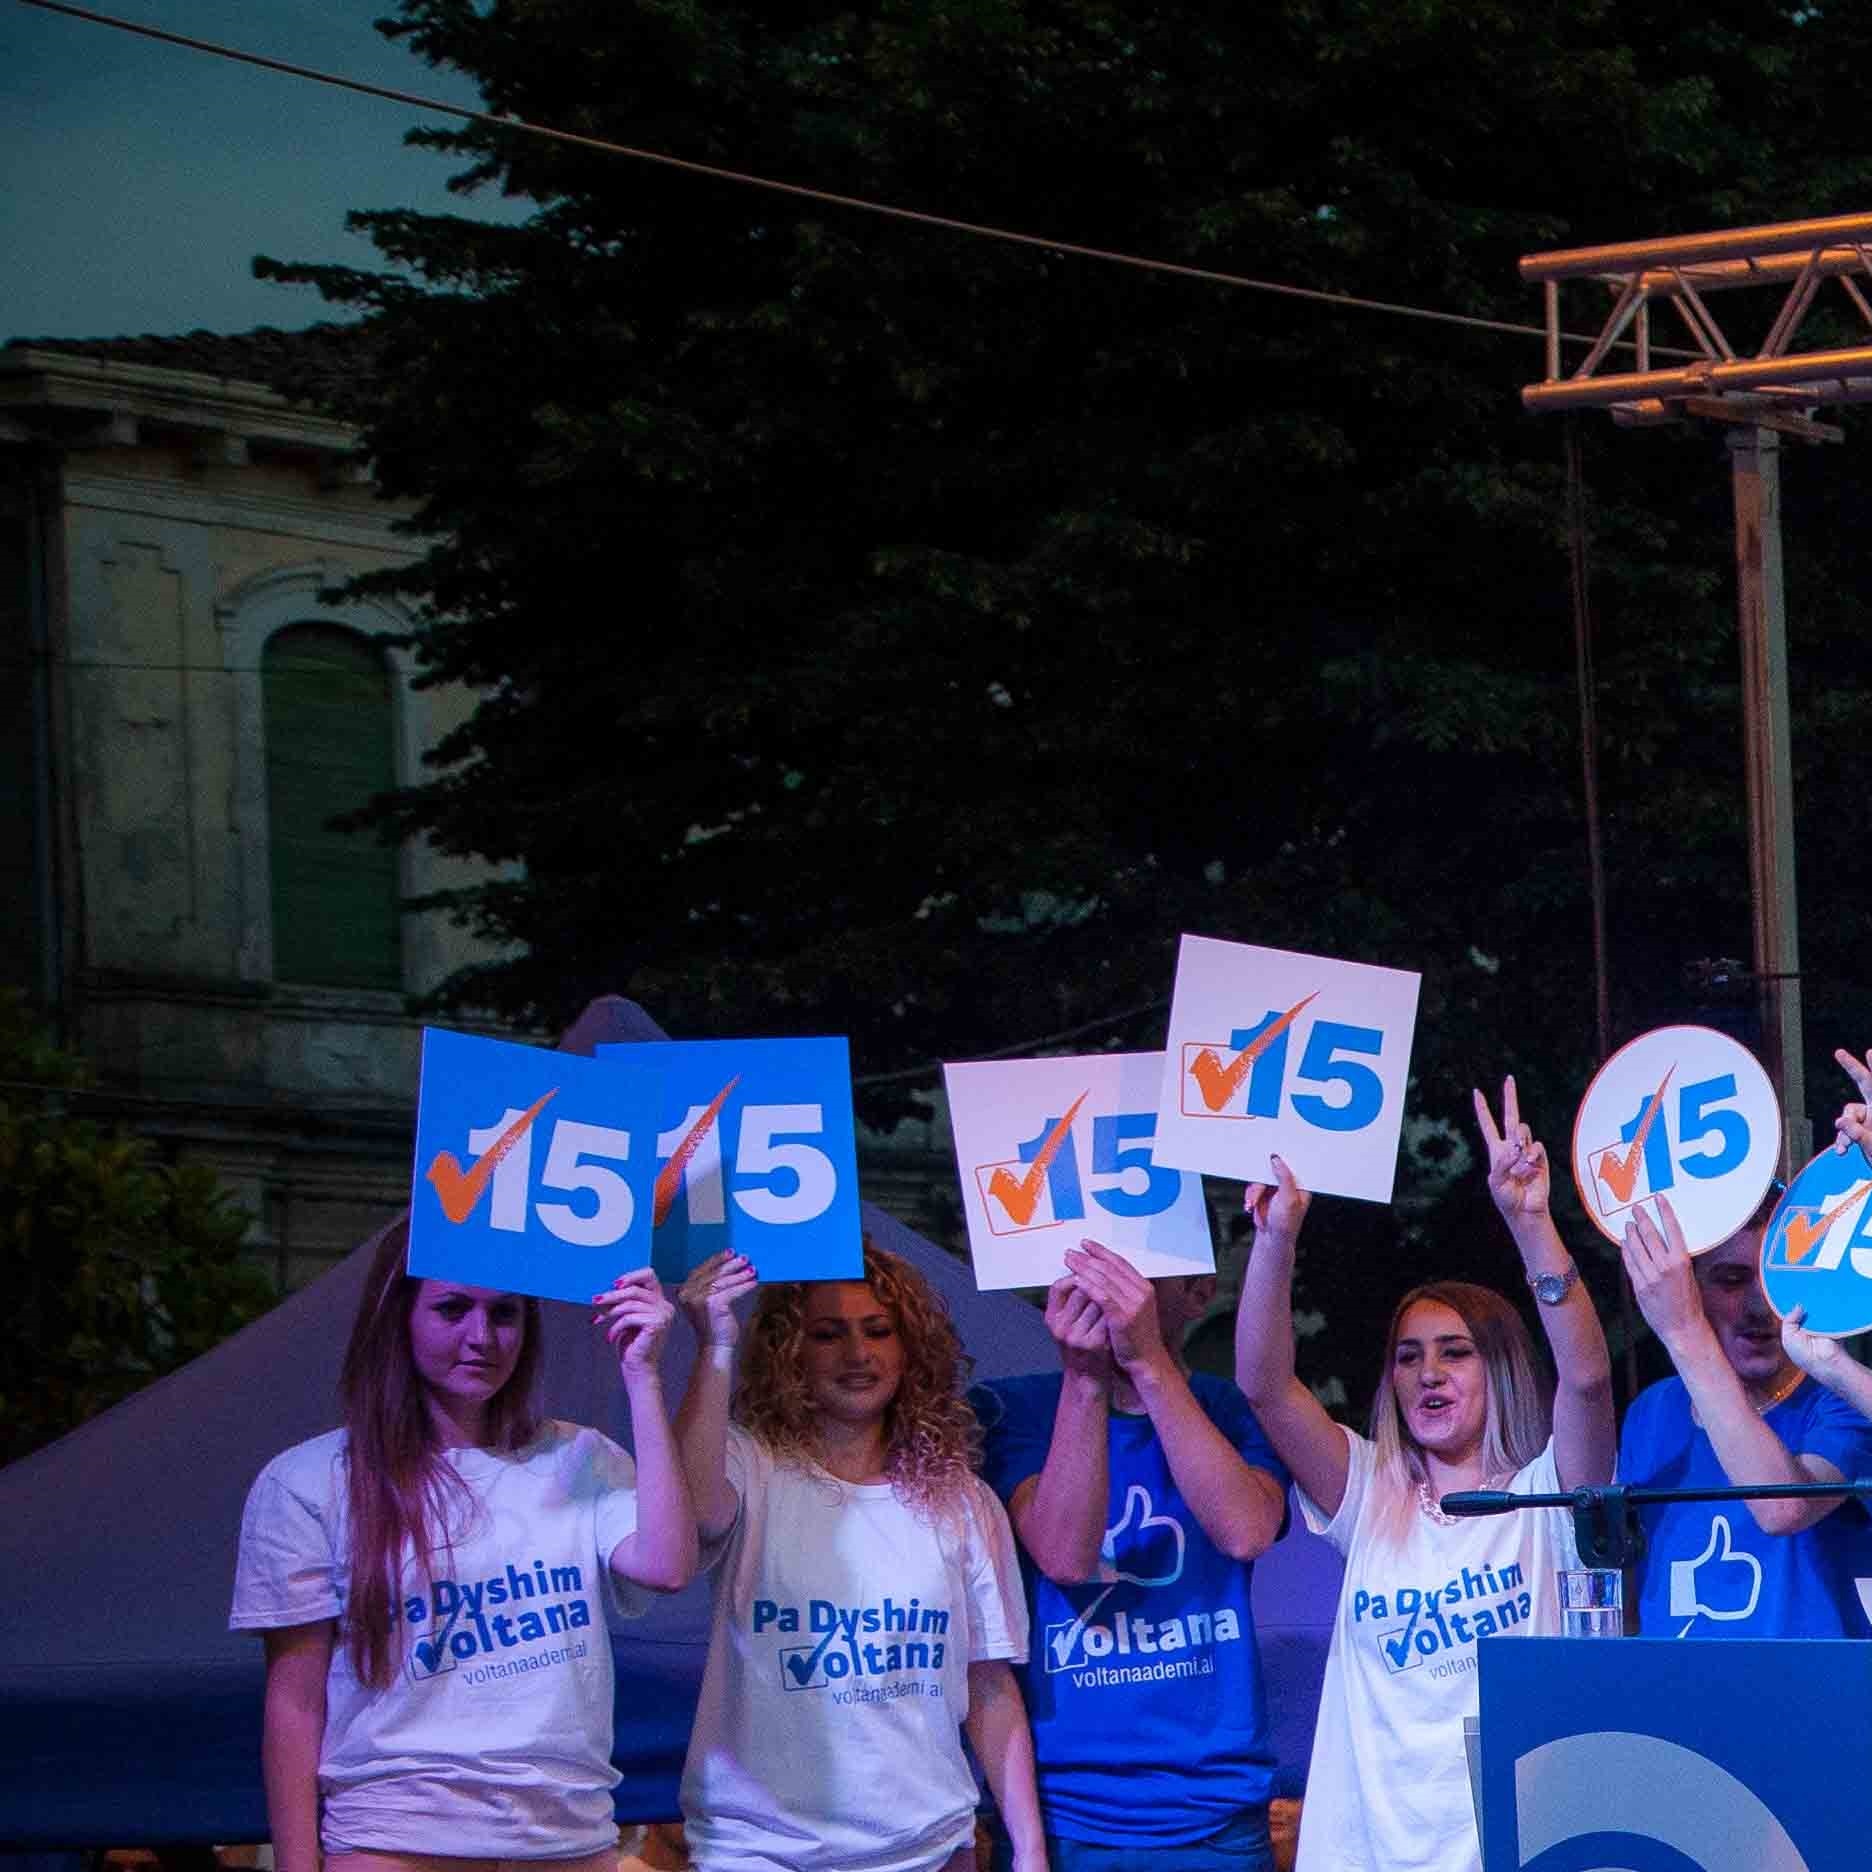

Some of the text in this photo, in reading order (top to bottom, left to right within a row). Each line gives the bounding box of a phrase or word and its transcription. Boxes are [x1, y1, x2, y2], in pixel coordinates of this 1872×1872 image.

[1229, 1008, 1385, 1134] 15
[466, 1104, 636, 1249] 15
[653, 1102, 838, 1227] 15
[1016, 1110, 1184, 1221] 15
[1619, 1072, 1753, 1195] 15
[431, 1560, 583, 1619] Dyshim
[753, 1598, 949, 1642] Pa Dyshim
[1353, 1561, 1524, 1623] Pa Dyshim
[1072, 1654, 1216, 1689] voltanaademi.al
